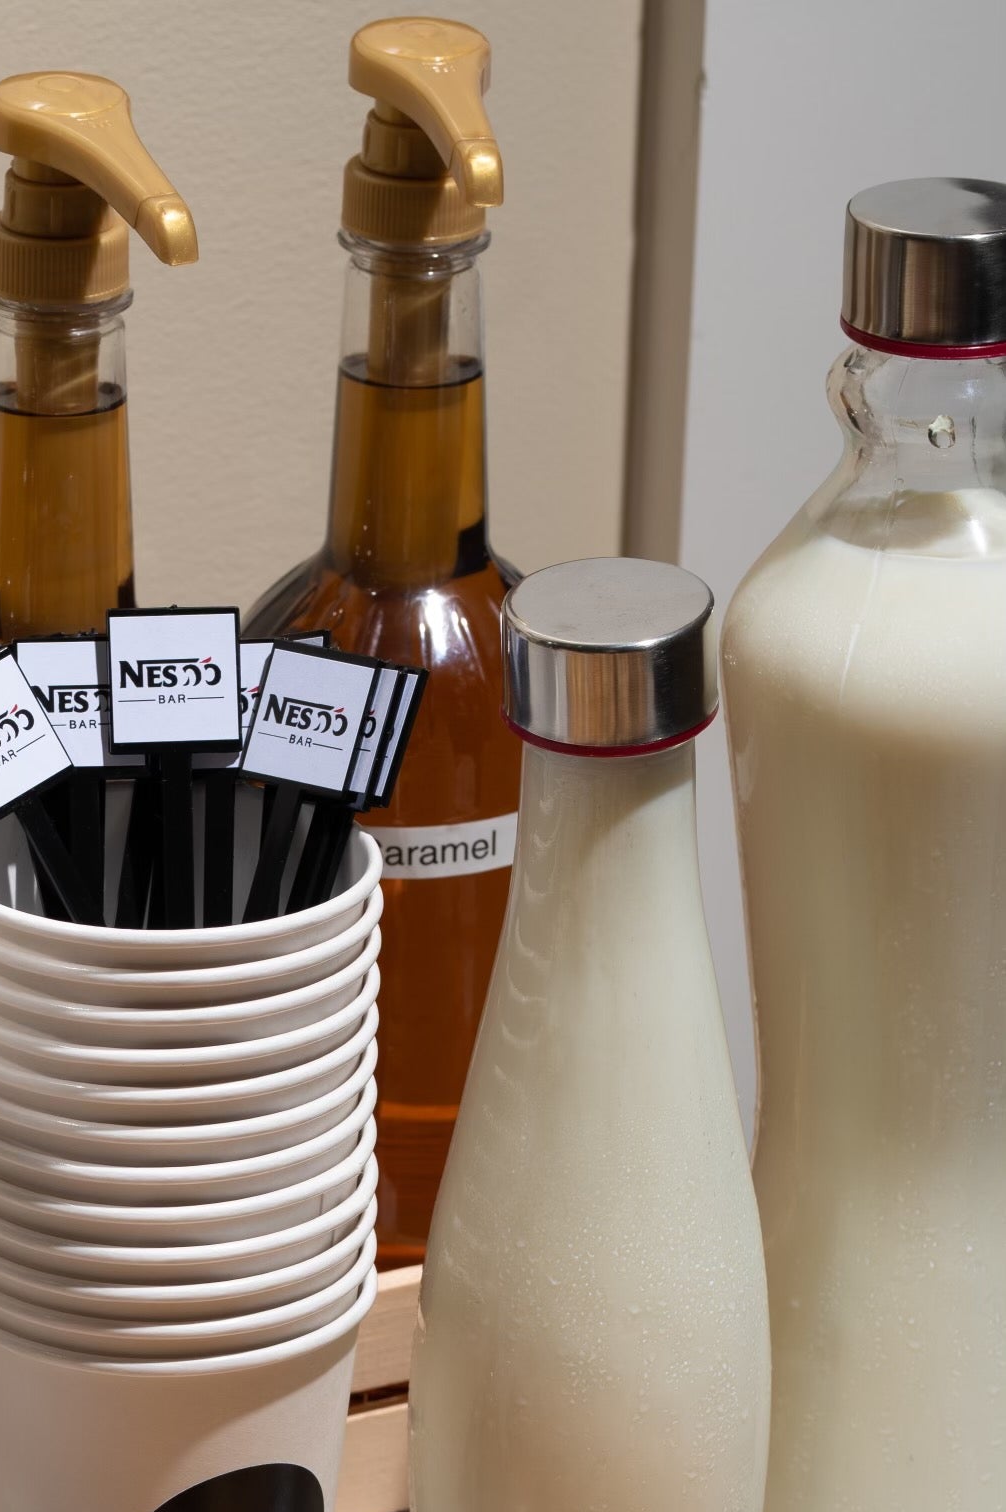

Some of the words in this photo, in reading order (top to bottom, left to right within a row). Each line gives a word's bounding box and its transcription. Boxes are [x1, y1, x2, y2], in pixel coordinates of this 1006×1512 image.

[158, 694, 186, 704] BAR
[69, 720, 97, 729] BAR
[288, 735, 312, 747] BAR
[376, 830, 496, 866] aramel
